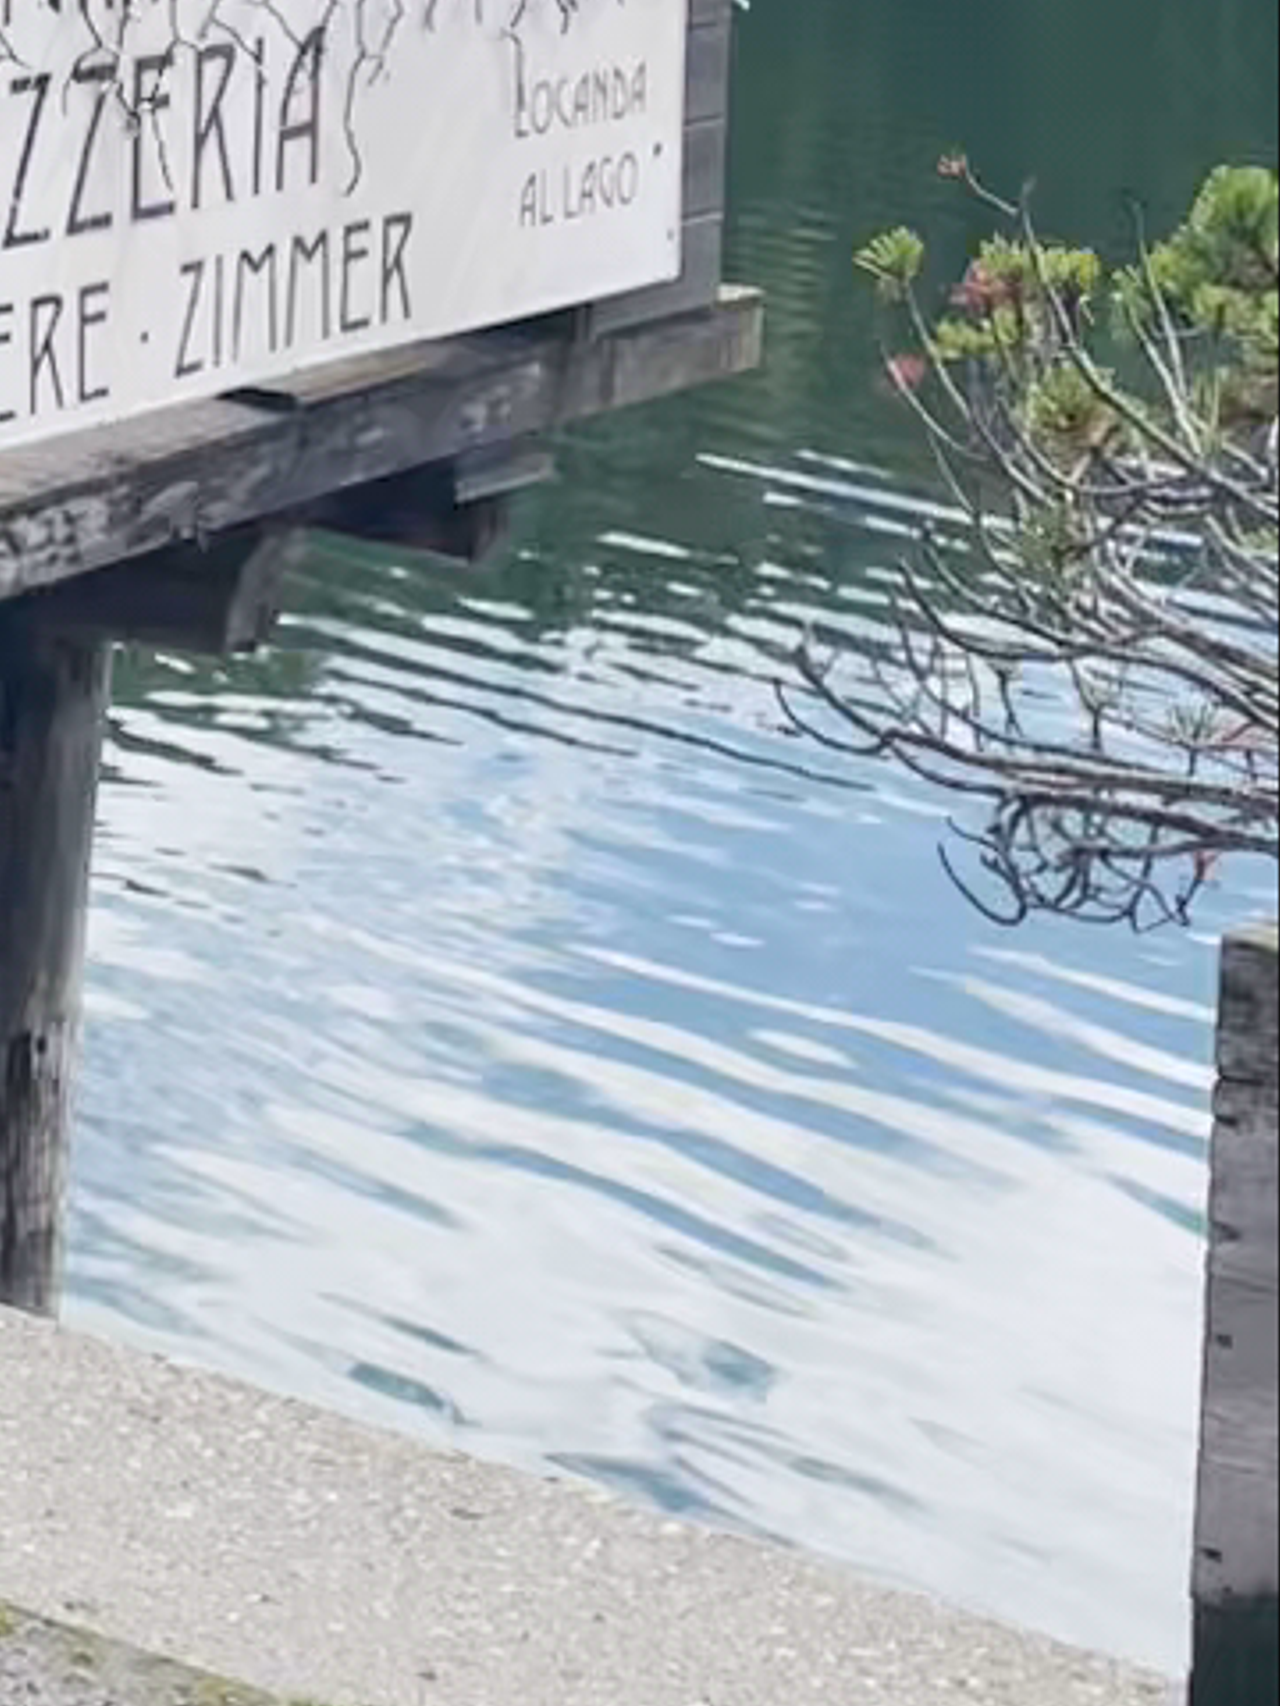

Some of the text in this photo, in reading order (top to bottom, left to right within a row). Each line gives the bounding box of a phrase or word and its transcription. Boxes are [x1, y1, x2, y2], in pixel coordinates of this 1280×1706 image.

[514, 62, 646, 139] LOCANDA
[519, 151, 638, 227] AL LAGO
[175, 212, 413, 379] ZIMMER
